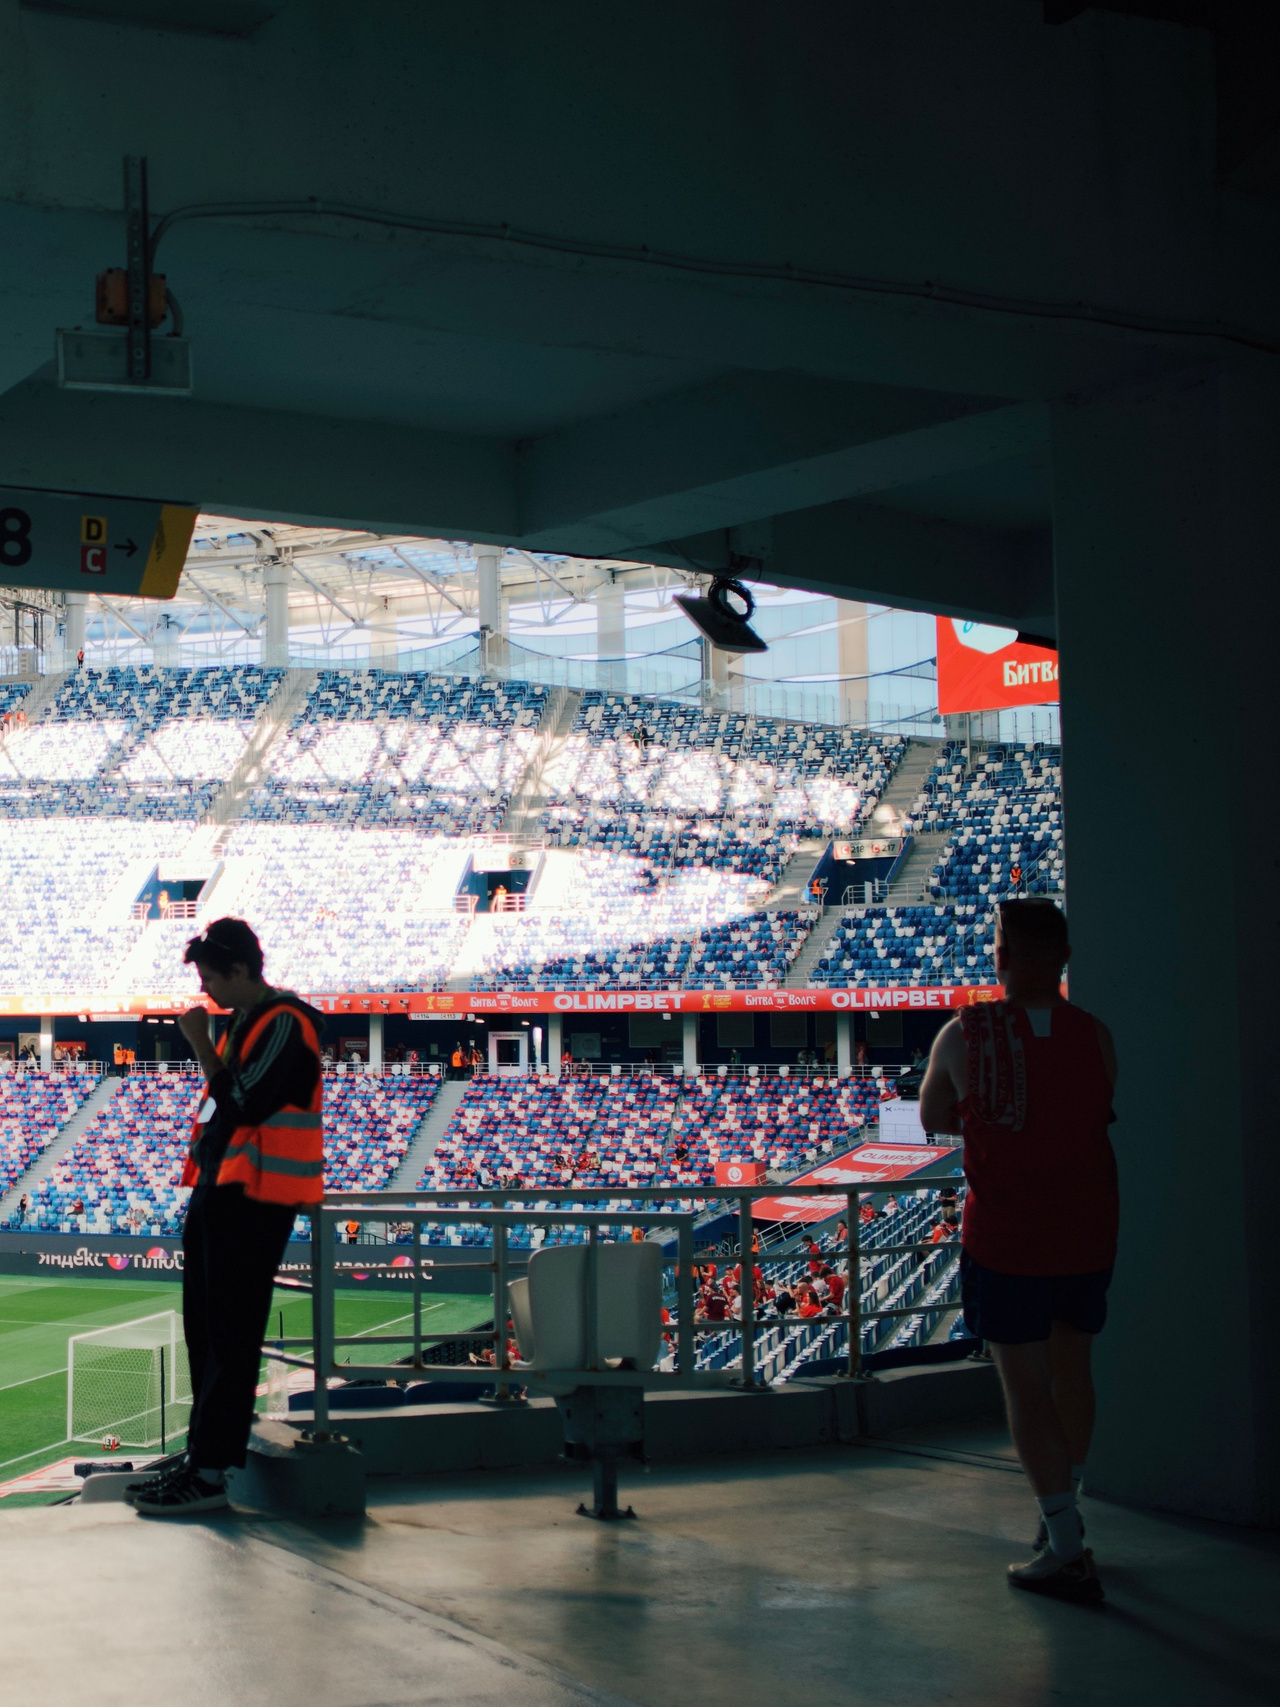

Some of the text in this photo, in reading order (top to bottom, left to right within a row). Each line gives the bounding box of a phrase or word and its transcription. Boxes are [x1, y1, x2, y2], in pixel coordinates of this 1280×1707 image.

[86, 518, 102, 542] D
[86, 549, 102, 573] C
[851, 845, 864, 854] 218
[882, 844, 895, 853] 217
[554, 994, 686, 1010] OLIMPBET
[831, 989, 955, 1008] OLIMPBET
[967, 1009, 980, 1095] MOSCOW
[861, 1151, 932, 1164] OLIMPBET
